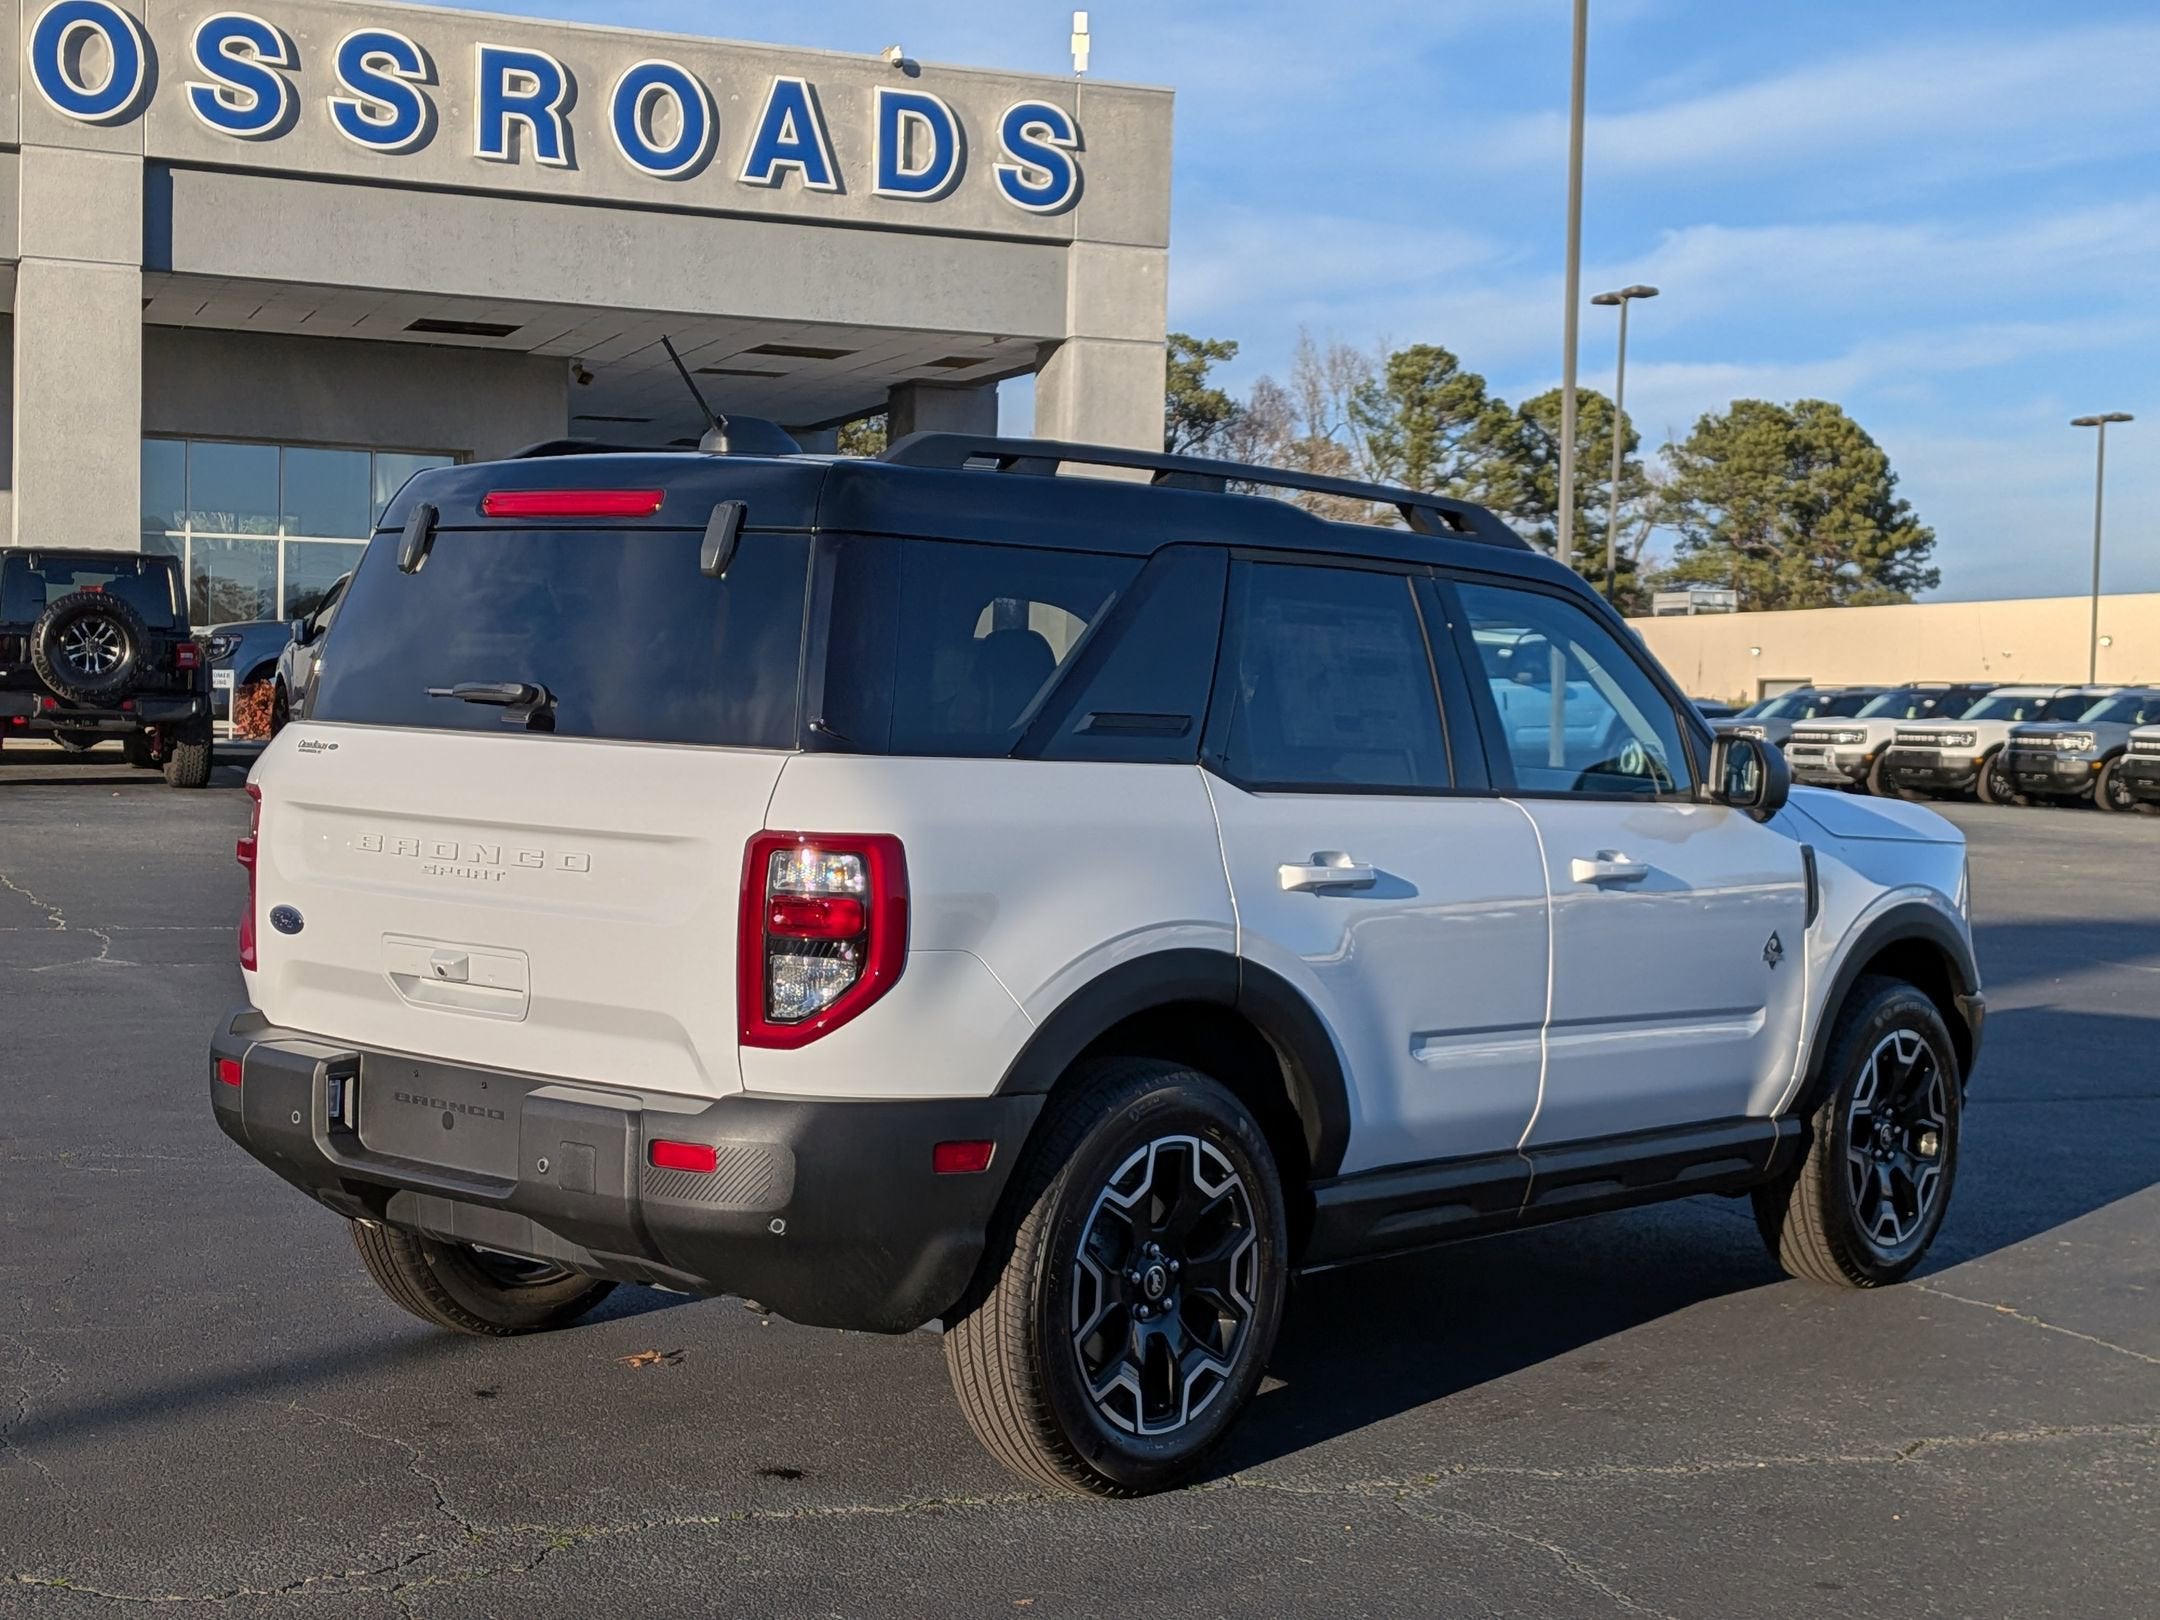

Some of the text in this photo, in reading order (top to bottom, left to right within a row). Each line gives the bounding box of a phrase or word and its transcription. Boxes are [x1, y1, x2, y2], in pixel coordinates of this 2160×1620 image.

[28, 0, 1078, 212] OSSROADS
[355, 832, 591, 873] BRONCO
[420, 864, 506, 882] SPORT
[394, 1091, 505, 1121] BRONCO
